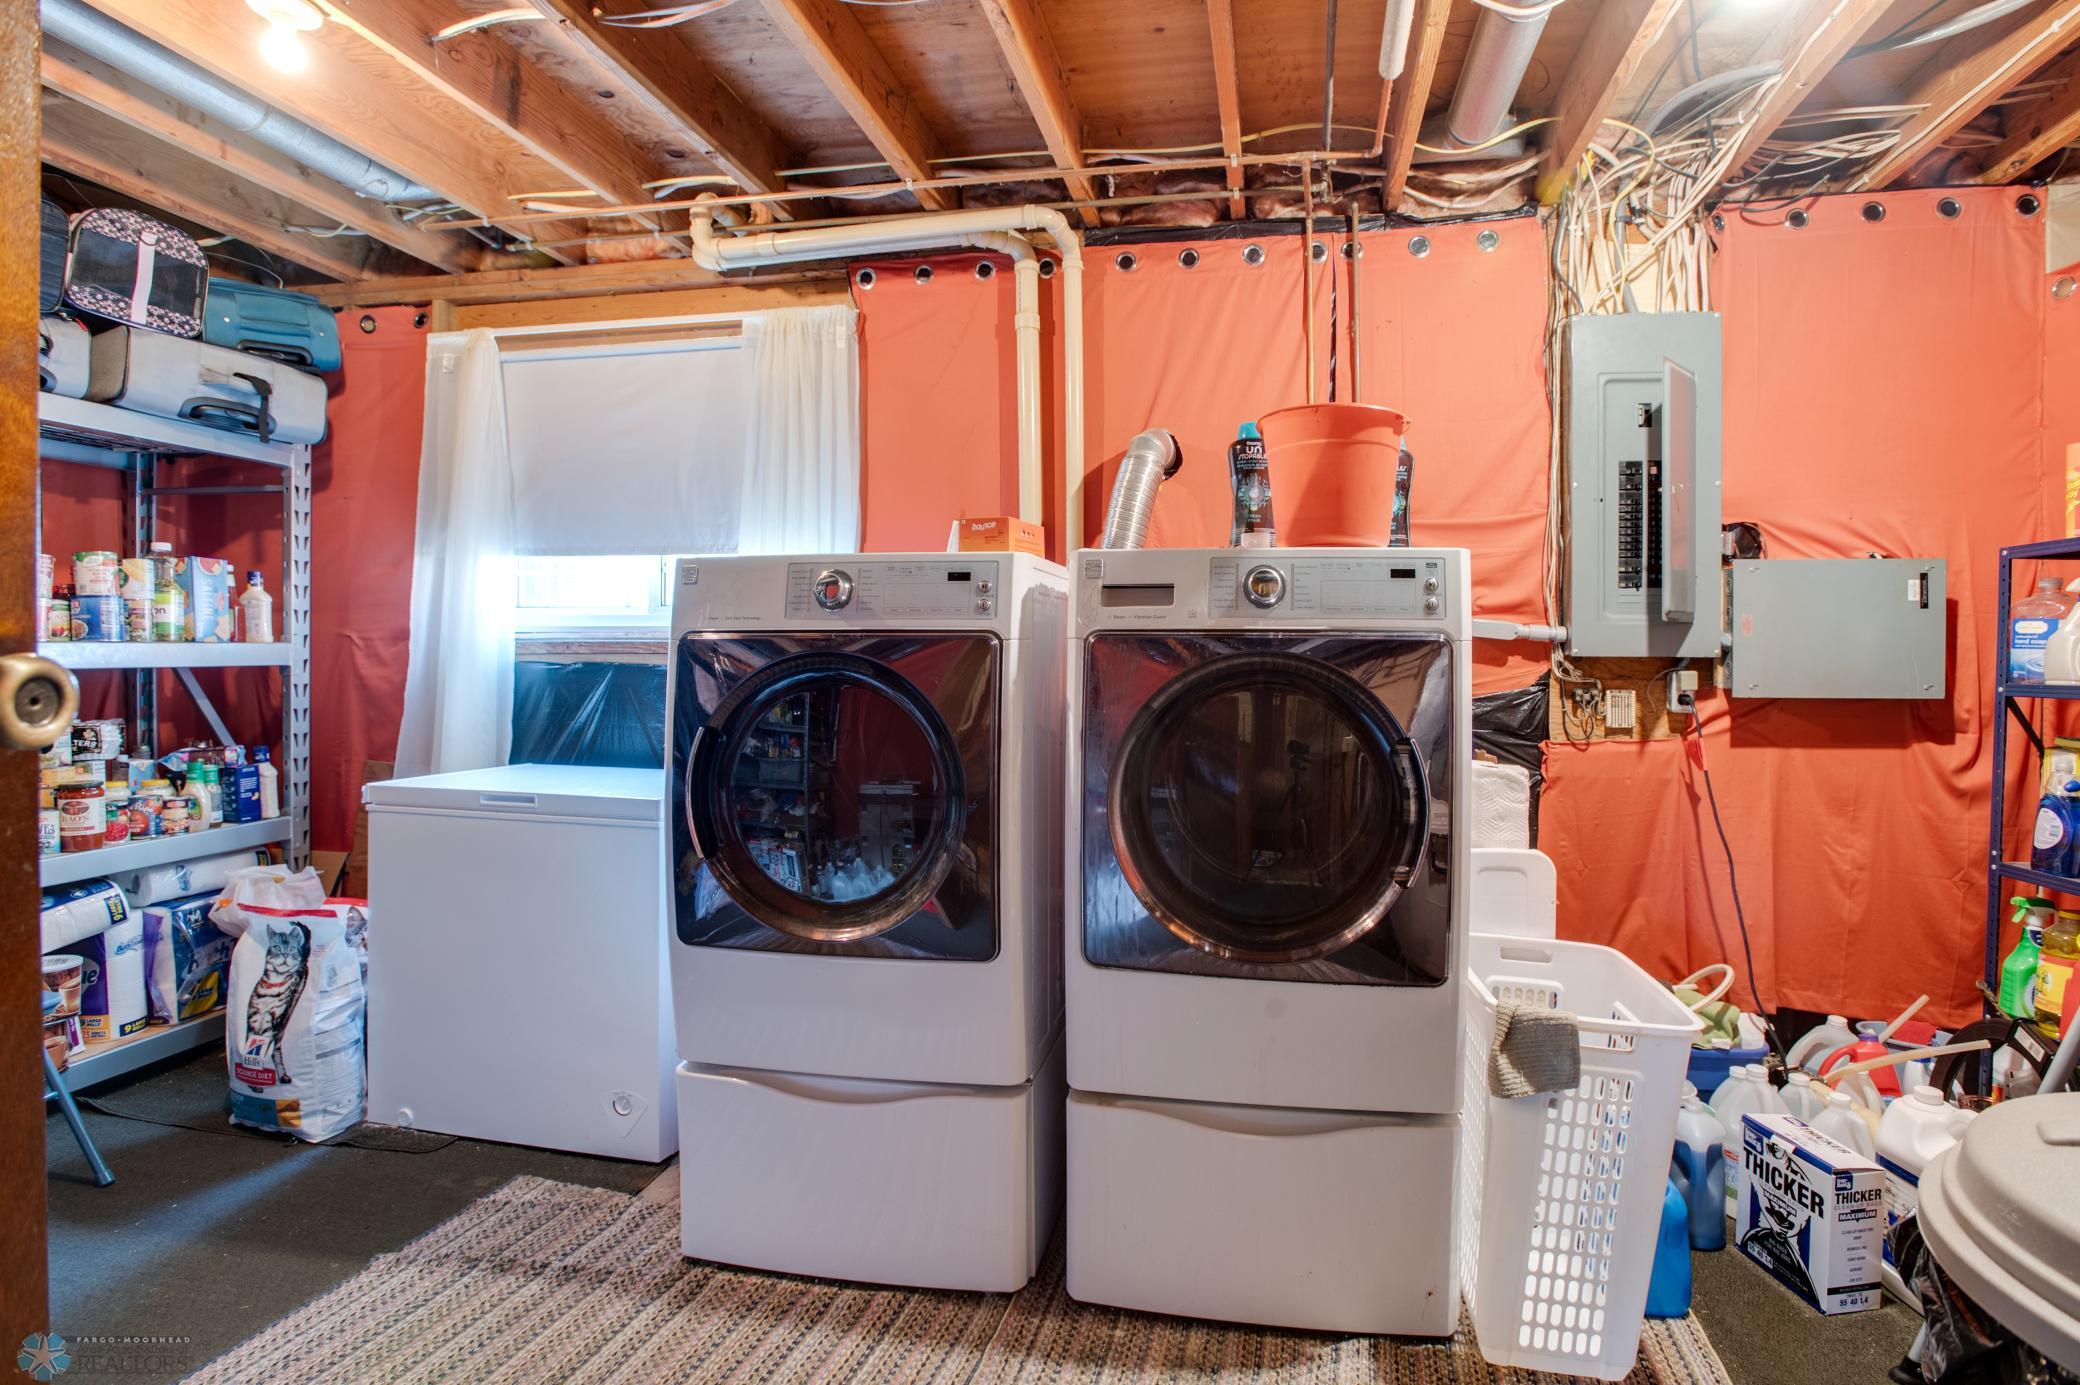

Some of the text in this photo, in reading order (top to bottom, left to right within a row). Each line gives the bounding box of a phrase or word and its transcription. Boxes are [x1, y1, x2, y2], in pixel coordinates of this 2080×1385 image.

[72, 740, 98, 749] TERS
[236, 1067, 272, 1080] SCIENCE DIET
[1743, 1146, 1824, 1219] THICKER
[1835, 1189, 1882, 1205] THICKER
[1840, 1211, 1876, 1220] MAXIMUM
